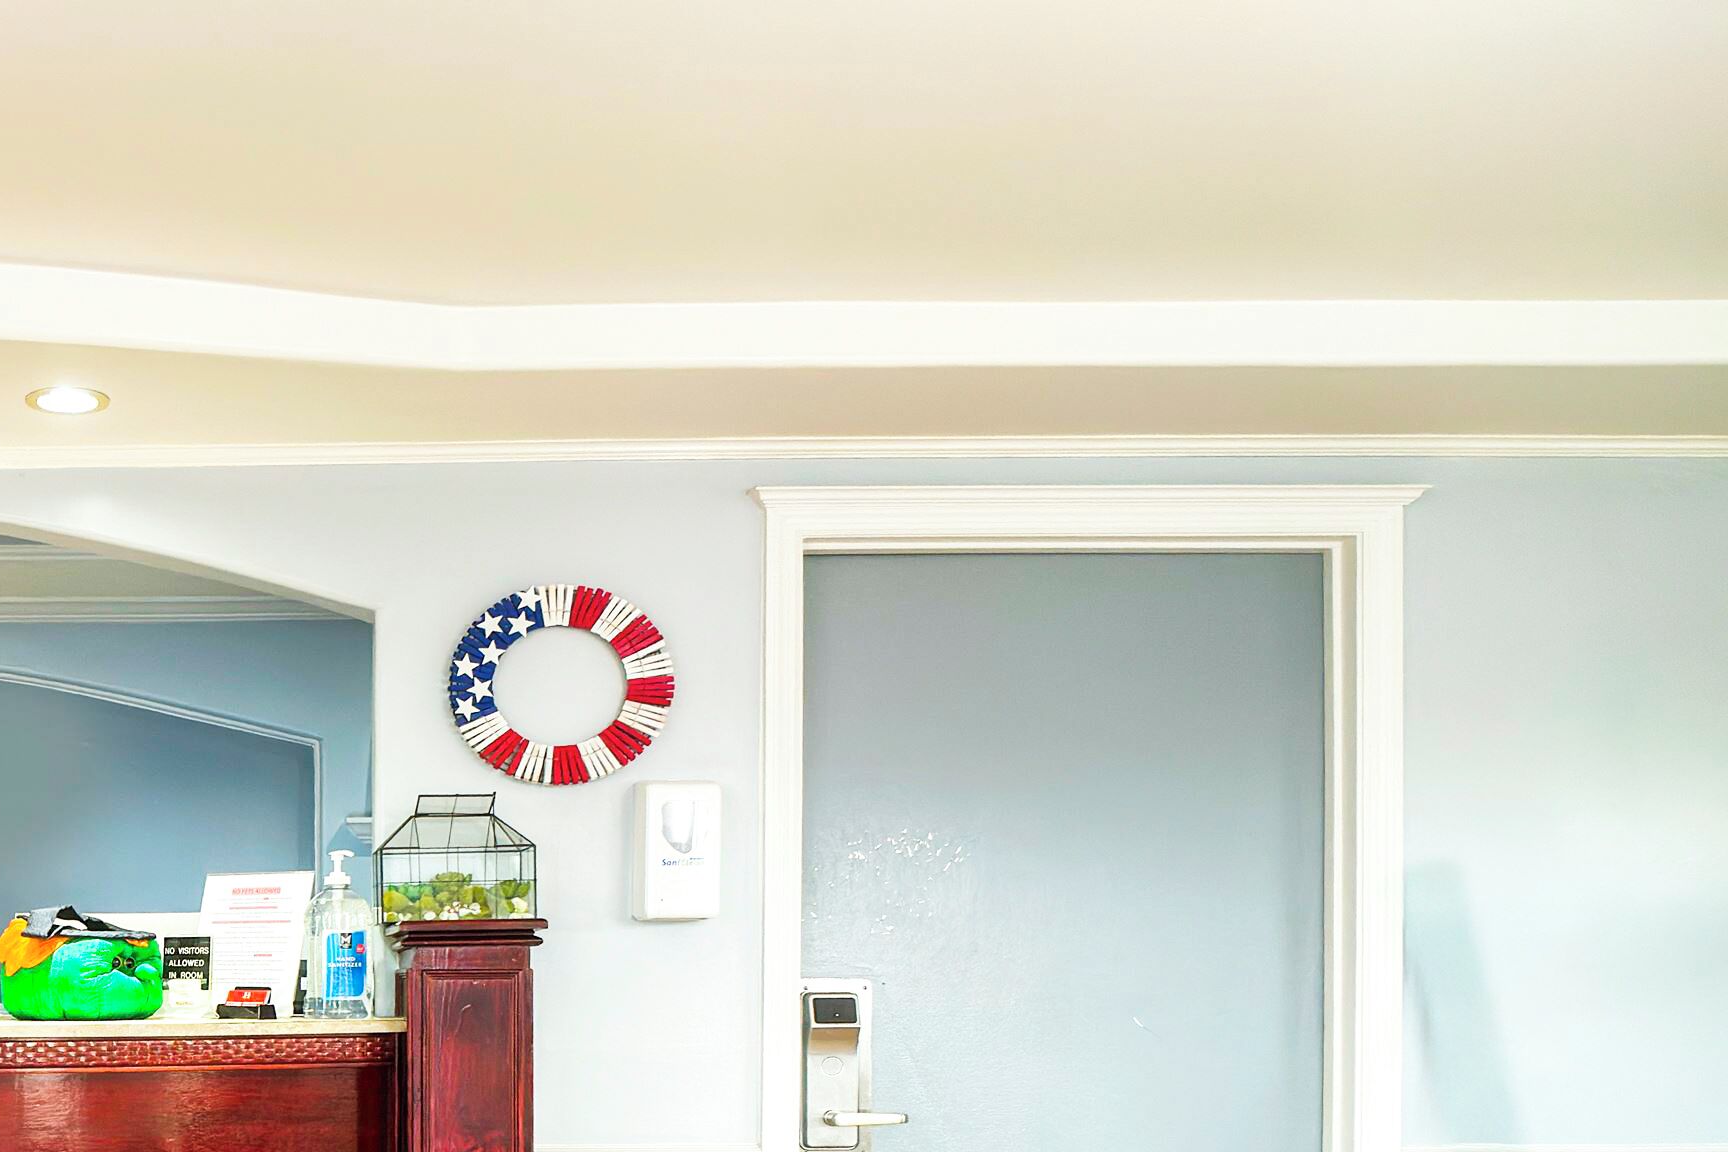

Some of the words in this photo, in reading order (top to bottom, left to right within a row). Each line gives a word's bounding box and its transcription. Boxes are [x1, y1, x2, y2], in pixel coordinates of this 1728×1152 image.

[164, 947, 175, 955] NO
[178, 946, 209, 955] VISITORS
[168, 959, 205, 967] ALLOWED
[168, 971, 177, 979] IN
[180, 971, 204, 980] ROOM
